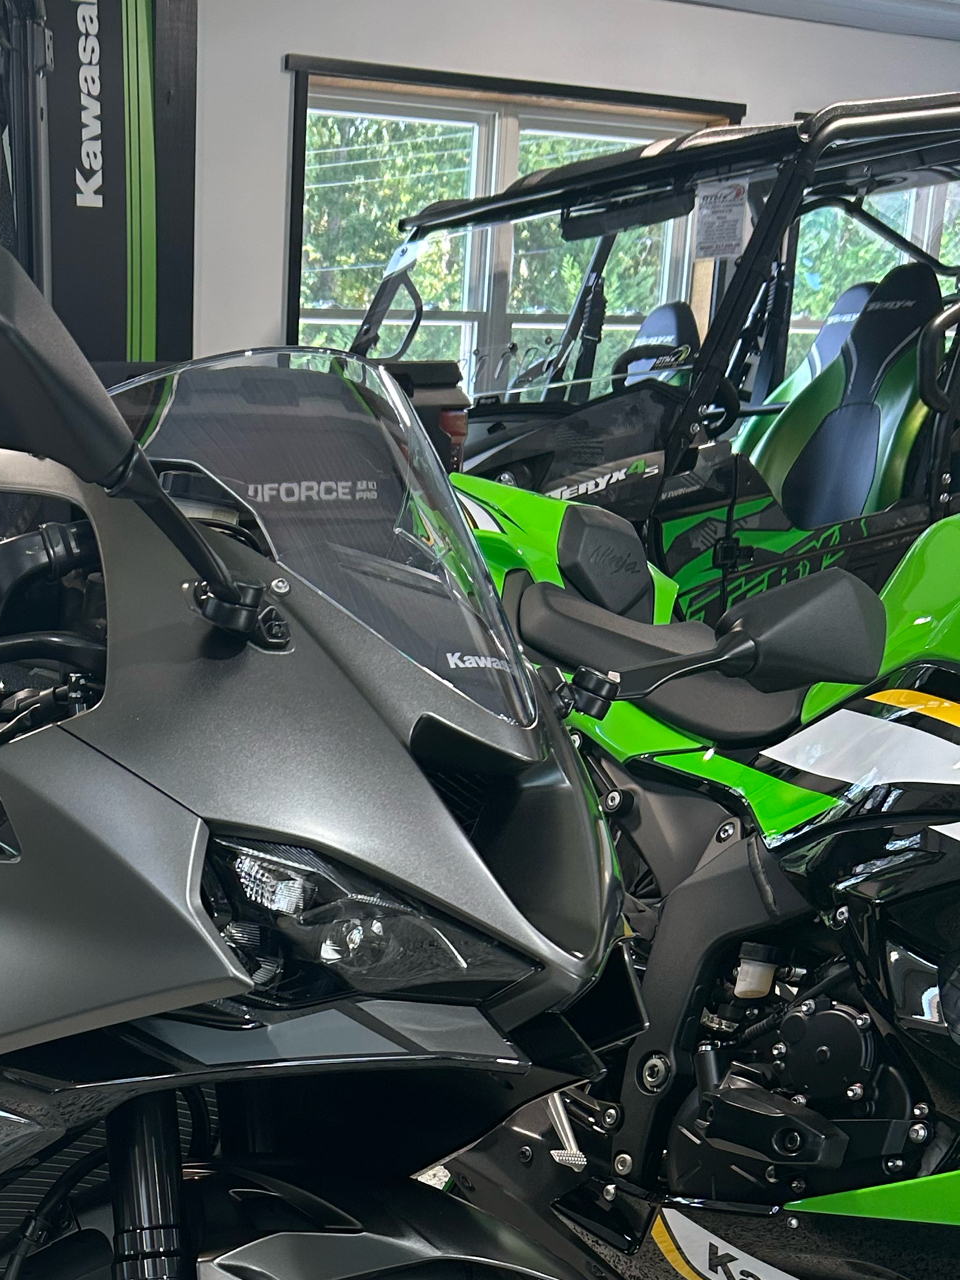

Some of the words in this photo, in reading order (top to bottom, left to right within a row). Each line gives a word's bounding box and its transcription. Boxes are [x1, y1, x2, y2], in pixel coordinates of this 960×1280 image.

[73, 0, 104, 208] Kawasa
[355, 491, 378, 500] PRO
[588, 545, 641, 575] Ninja
